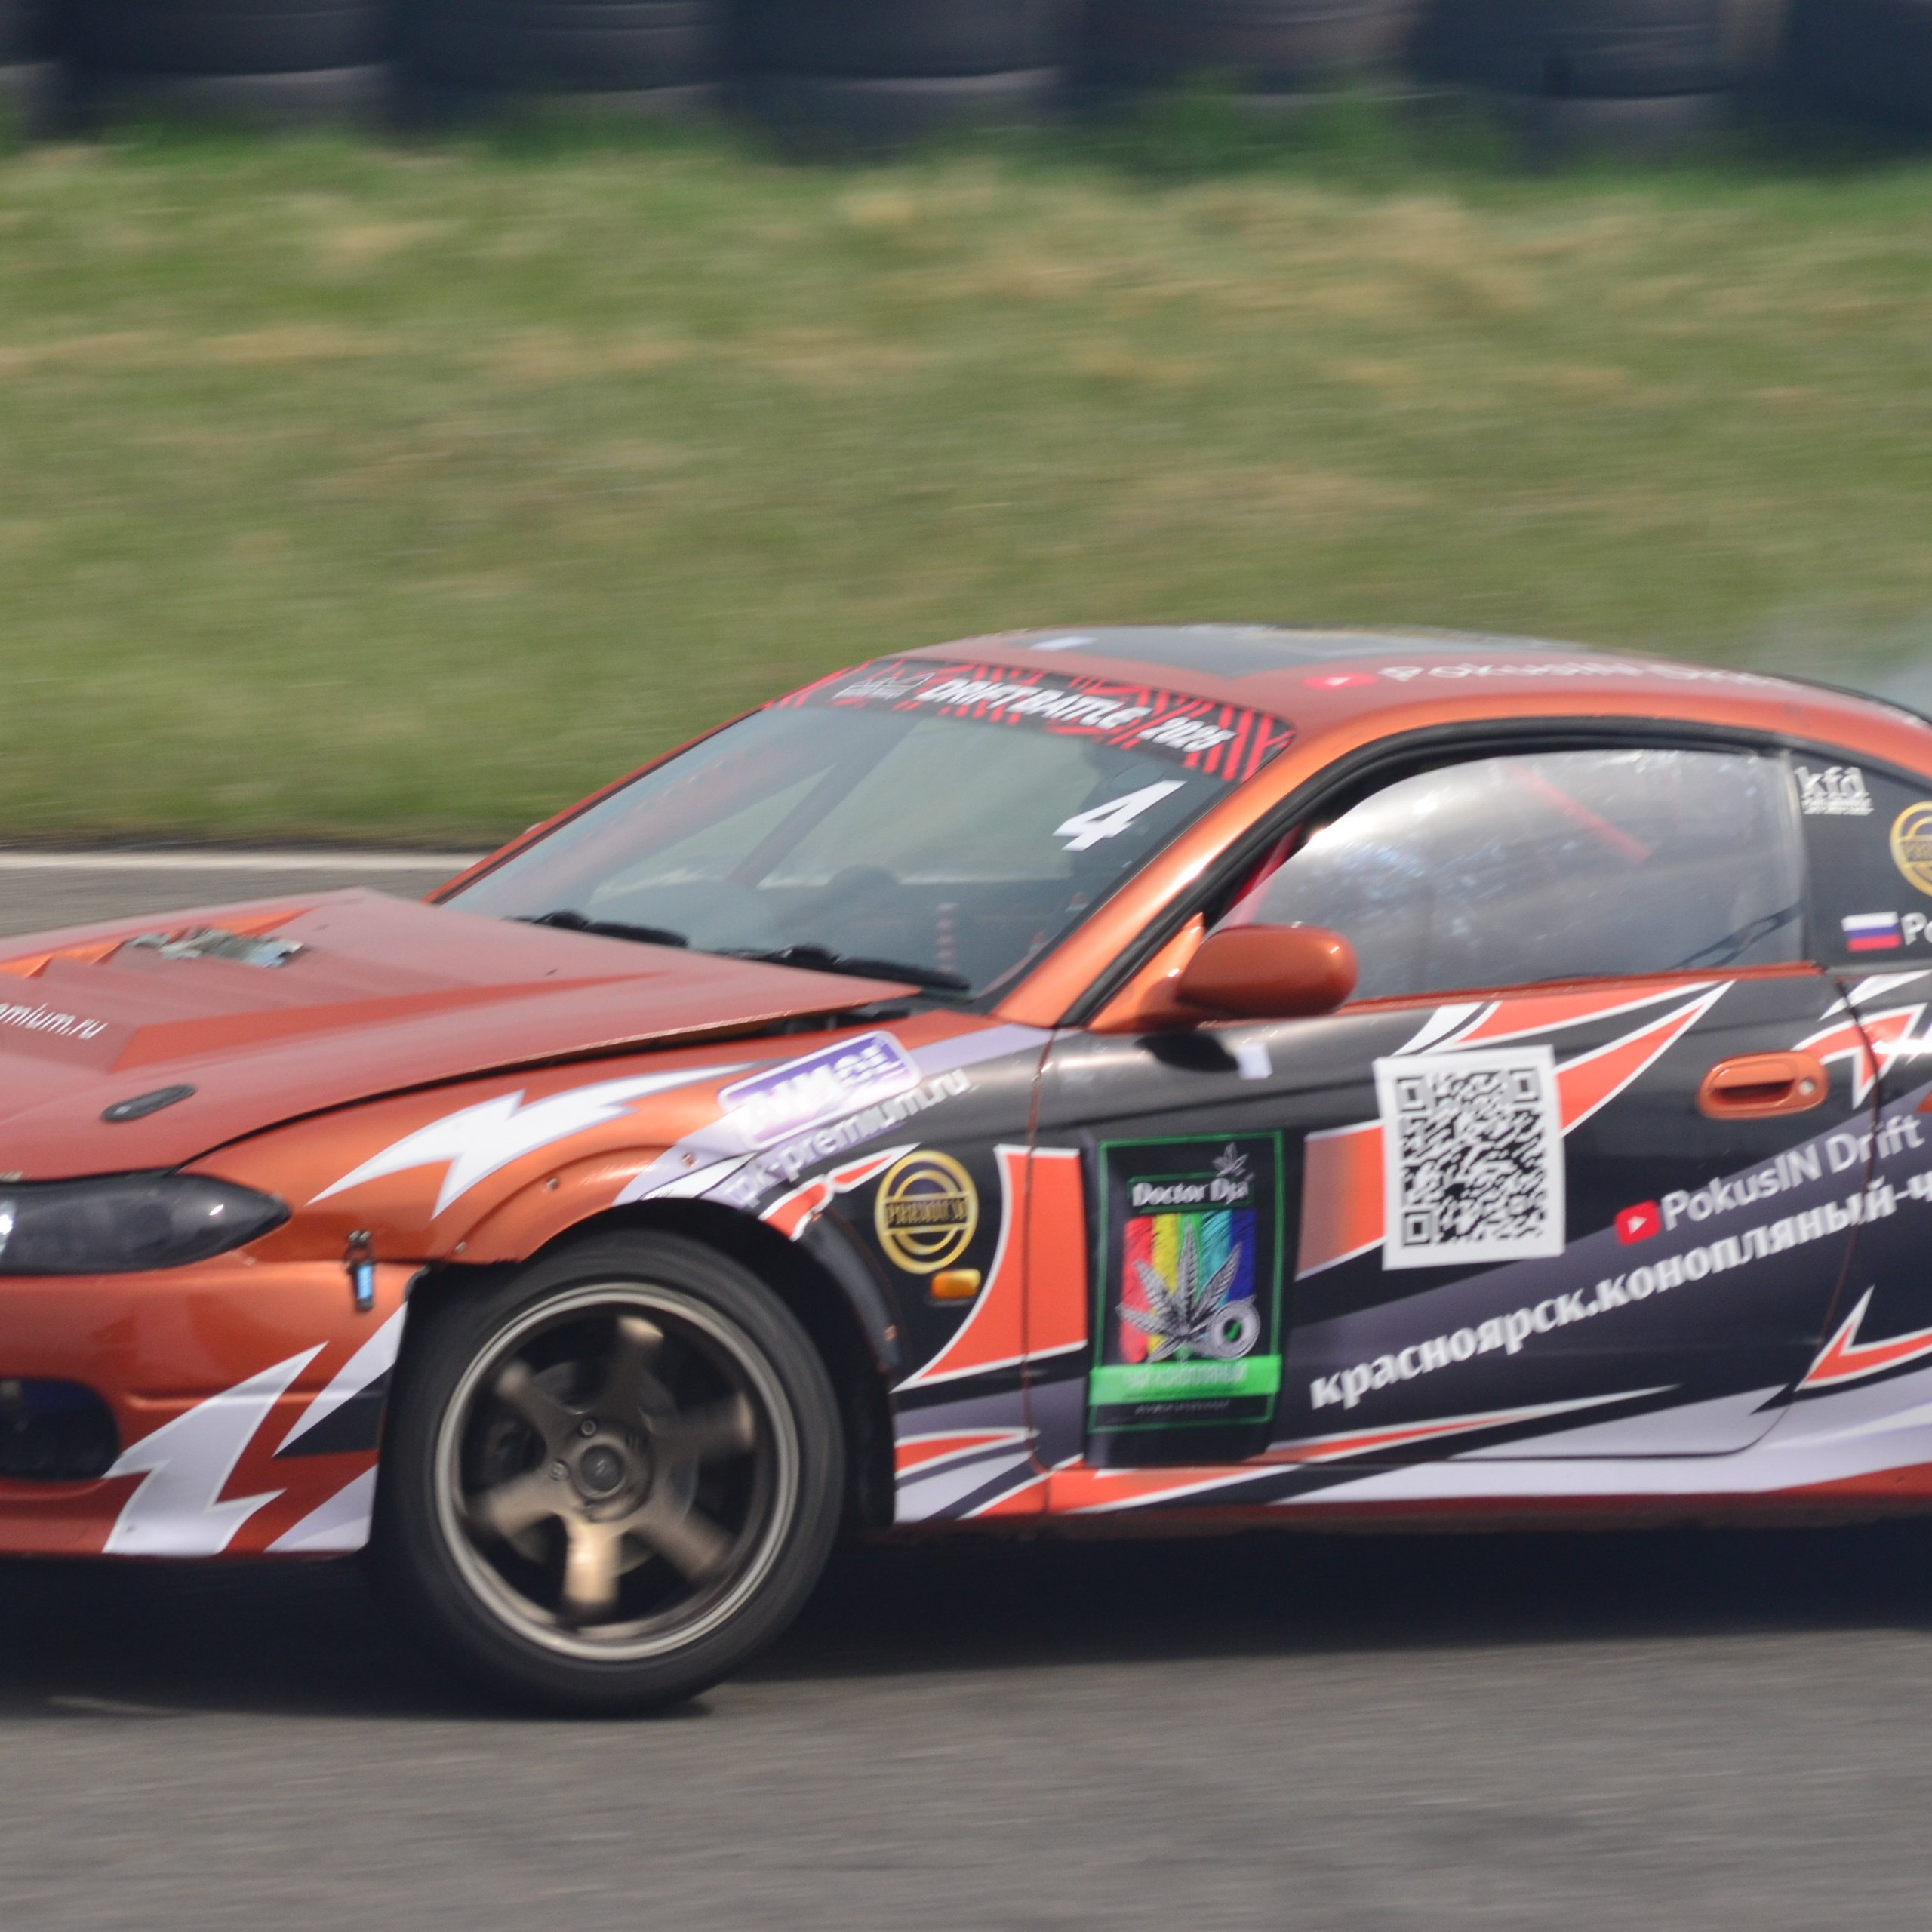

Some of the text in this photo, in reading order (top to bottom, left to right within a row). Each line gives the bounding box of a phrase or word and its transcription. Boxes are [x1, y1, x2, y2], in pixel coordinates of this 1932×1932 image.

[1794, 765, 1870, 800] kfd
[1052, 780, 1187, 851] 4
[1132, 1182, 1209, 1207] Doctor
[1661, 1115, 1926, 1230] PokusIN Drift
